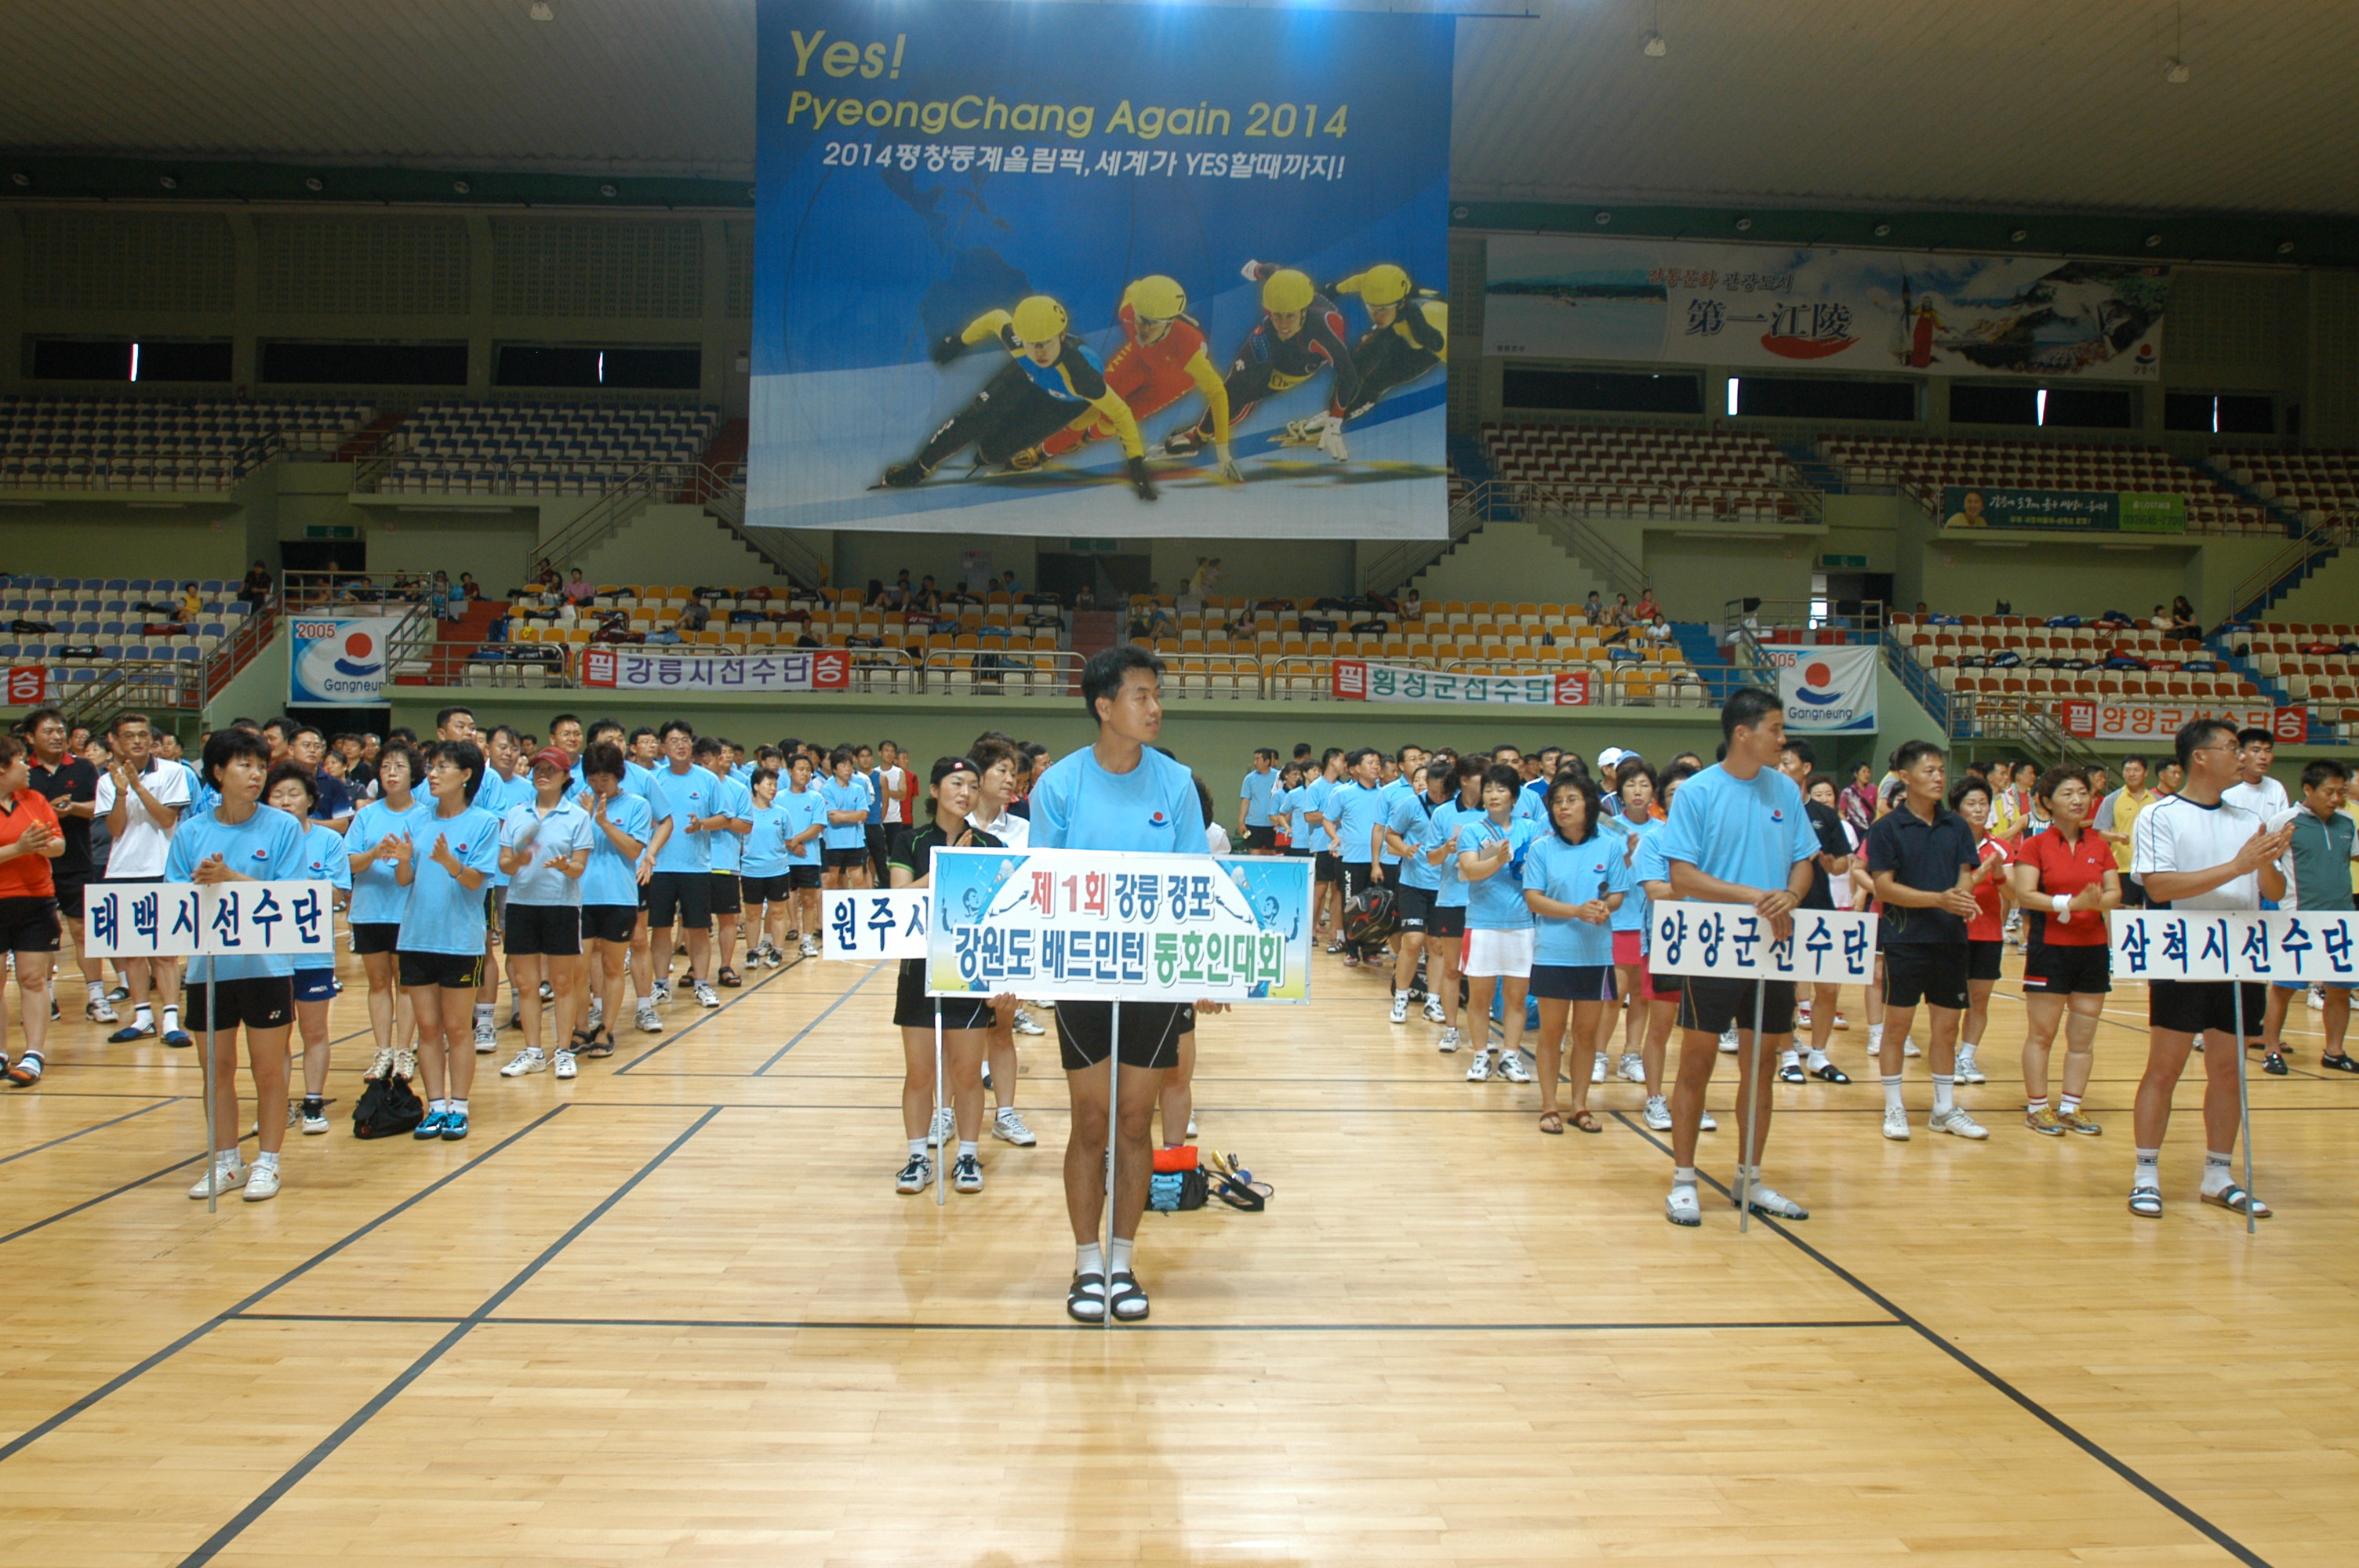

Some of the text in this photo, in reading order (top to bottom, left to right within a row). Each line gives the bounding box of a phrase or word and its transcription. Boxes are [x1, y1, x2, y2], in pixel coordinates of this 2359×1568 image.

[790, 31, 907, 79] Yes!
[787, 91, 1350, 140] PyeongChang Again 2014
[1184, 152, 1346, 182] YES할때까지!
[1647, 267, 1794, 294] 전통문화 관광도시
[1176, 295, 1185, 311] 7
[1685, 298, 1853, 339] 第一江陵
[297, 623, 336, 639] 2005
[13, 671, 39, 699] 승
[324, 678, 384, 693] Gangneun
[589, 655, 842, 685] 필 강릉시선수단 승
[1339, 665, 1583, 704] 필 횡성군선수단 승
[1789, 706, 1852, 720] Gangneung
[2070, 706, 2093, 731] 필
[2277, 712, 2302, 738] 승
[1114, 873, 1162, 921] 강릉
[1167, 875, 1213, 920] 경포
[91, 888, 322, 951] 태백시선수단
[954, 927, 1285, 986] 강원도 배드민턴 동호인대회
[1660, 909, 1868, 975] 양양군선수단
[2121, 917, 2354, 975] 삼척시선수단
